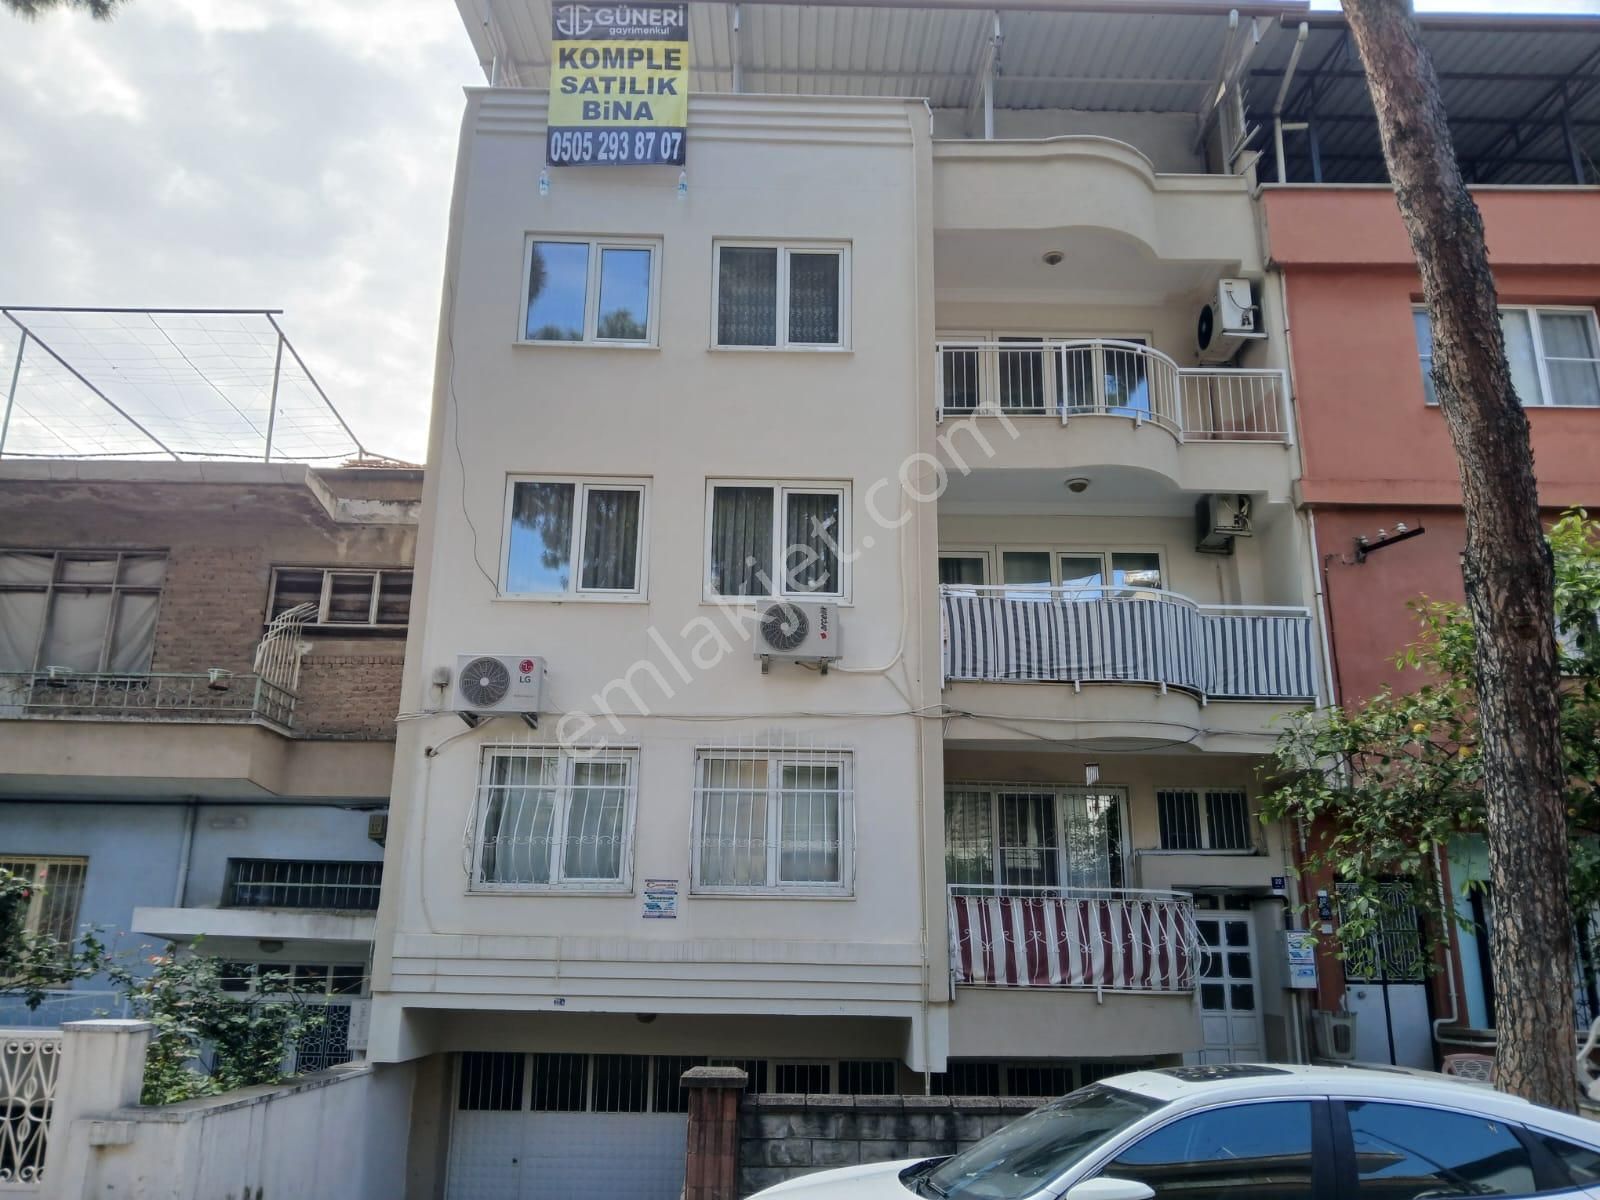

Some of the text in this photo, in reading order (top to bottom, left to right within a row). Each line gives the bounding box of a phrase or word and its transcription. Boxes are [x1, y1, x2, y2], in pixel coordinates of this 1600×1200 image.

[595, 6, 684, 26] GÜNERİ
[609, 27, 670, 35] gayrimenkul
[559, 47, 681, 70] KOMPLE
[560, 76, 677, 95] SATILIK
[550, 131, 682, 161] 0505 293 87 07
[519, 675, 531, 684] LG
